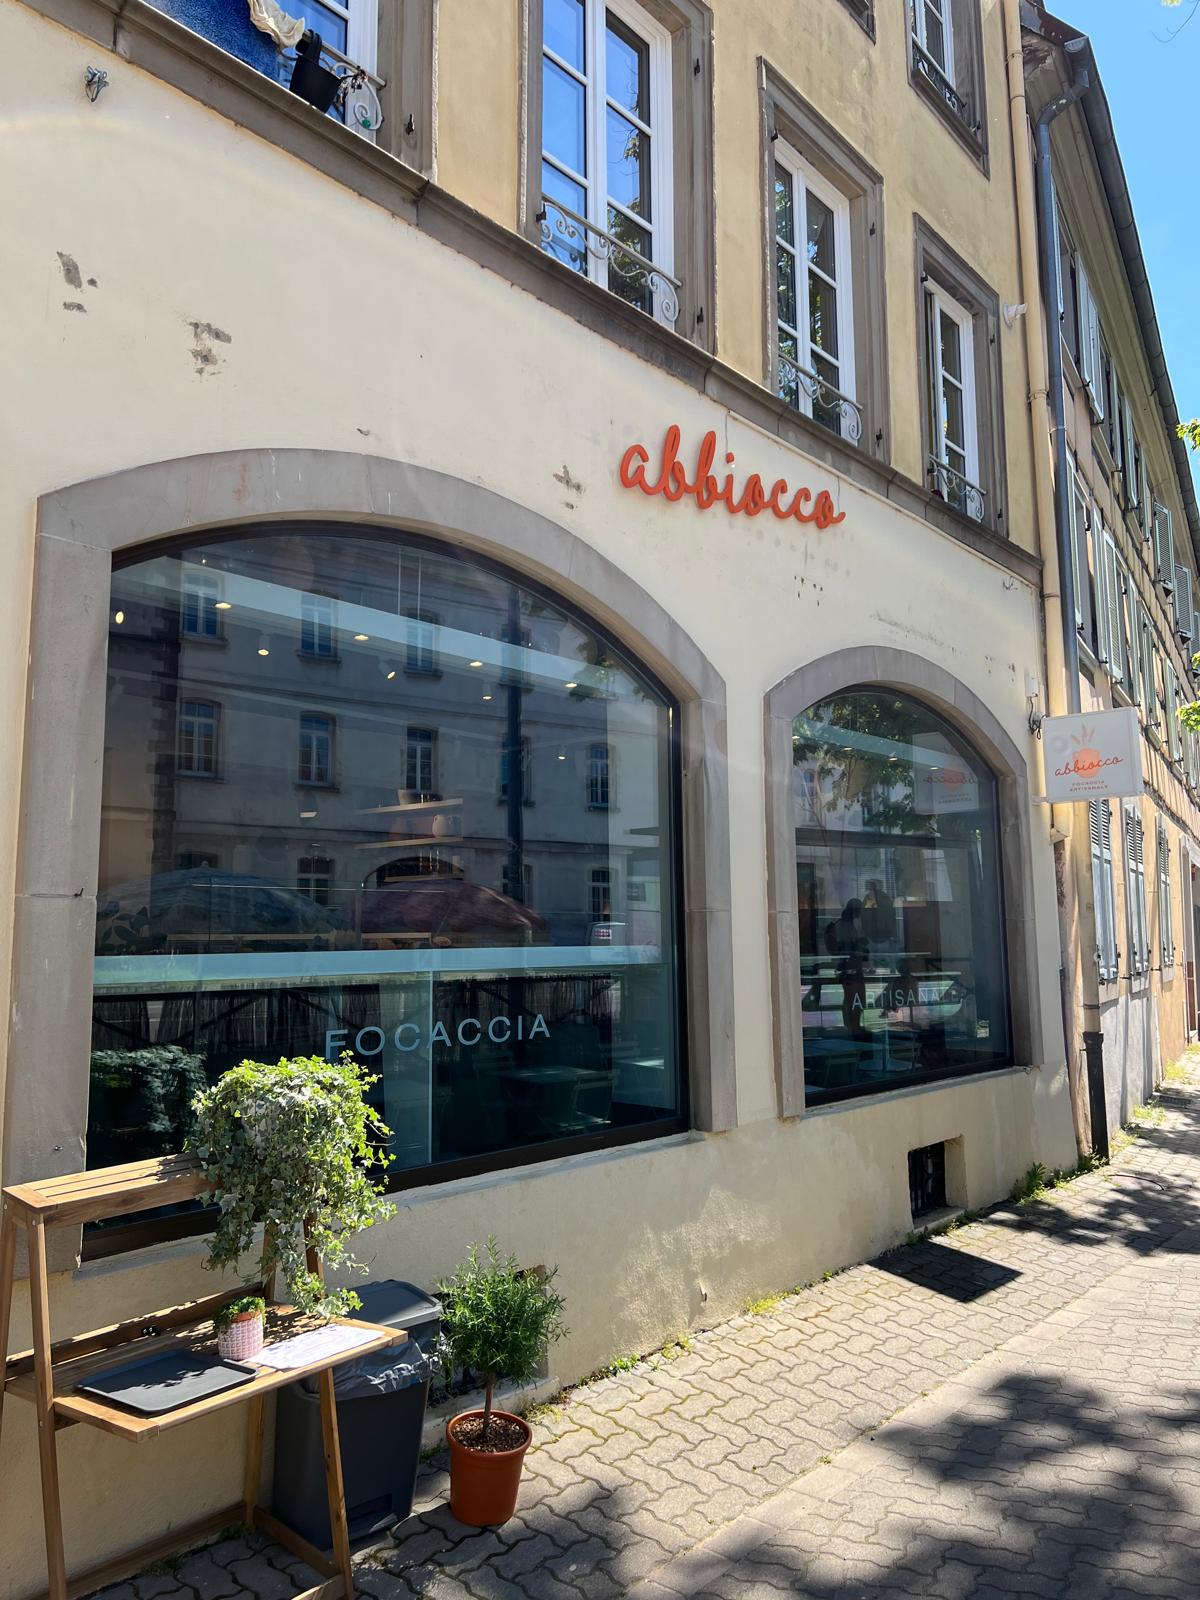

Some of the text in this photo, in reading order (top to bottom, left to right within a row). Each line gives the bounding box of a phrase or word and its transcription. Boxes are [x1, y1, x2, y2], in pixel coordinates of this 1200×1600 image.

[620, 424, 846, 529] abbiocco
[1054, 756, 1124, 777] abbiocco
[325, 1013, 551, 1061] FOCACCIA
